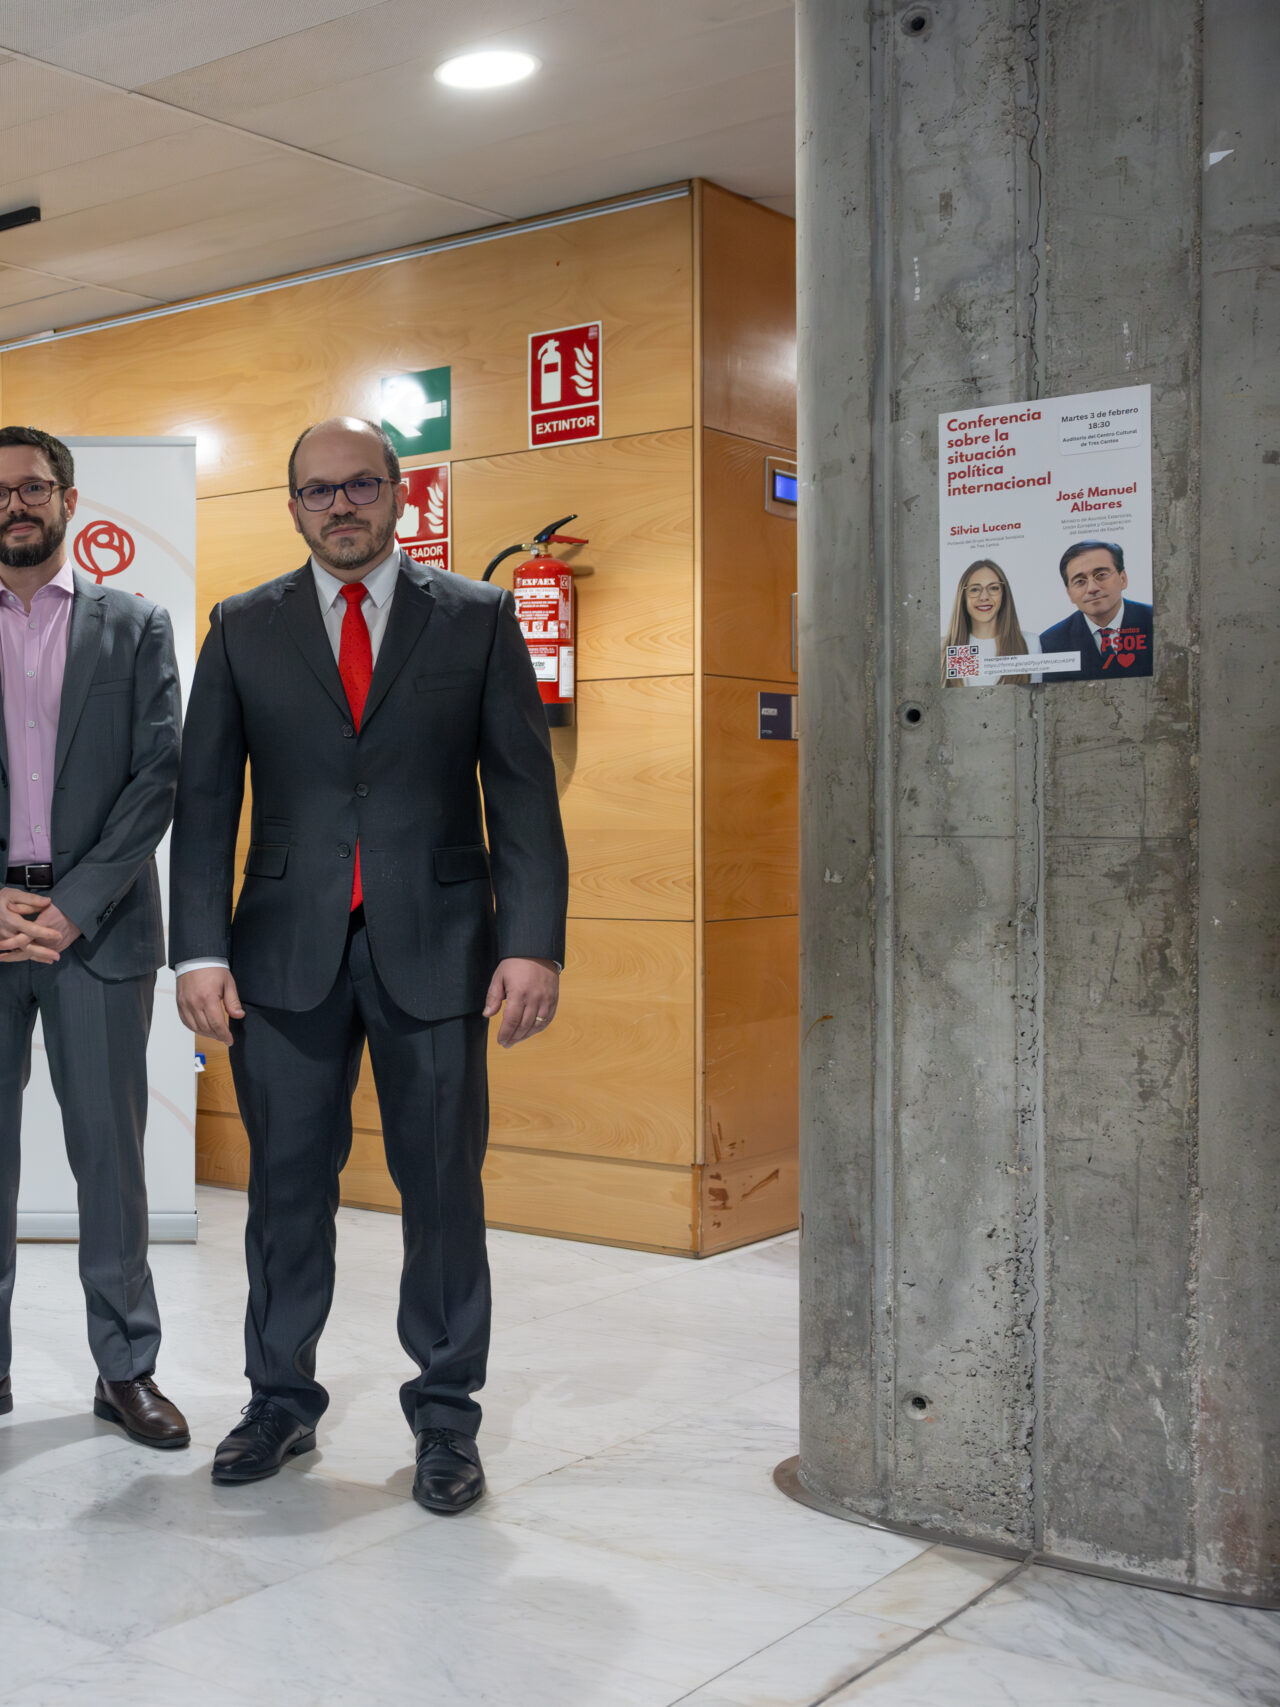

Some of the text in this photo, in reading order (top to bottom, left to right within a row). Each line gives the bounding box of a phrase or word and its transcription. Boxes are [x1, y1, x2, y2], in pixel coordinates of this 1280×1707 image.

[536, 415, 595, 435] EXTINTOR
[947, 408, 1042, 432] Conferencia
[1061, 414, 1088, 423] Martes
[1108, 407, 1139, 416] febrero
[1088, 420, 1111, 430] 18:30
[947, 428, 1009, 449] sobre la
[947, 444, 1016, 465] situación
[947, 463, 1004, 484] política
[947, 471, 1051, 496] internacional
[1056, 482, 1137, 502] José Manuel
[1070, 500, 1123, 513] Albares
[950, 522, 1022, 537] Silvia Lucena
[1101, 634, 1147, 652] PSOE
